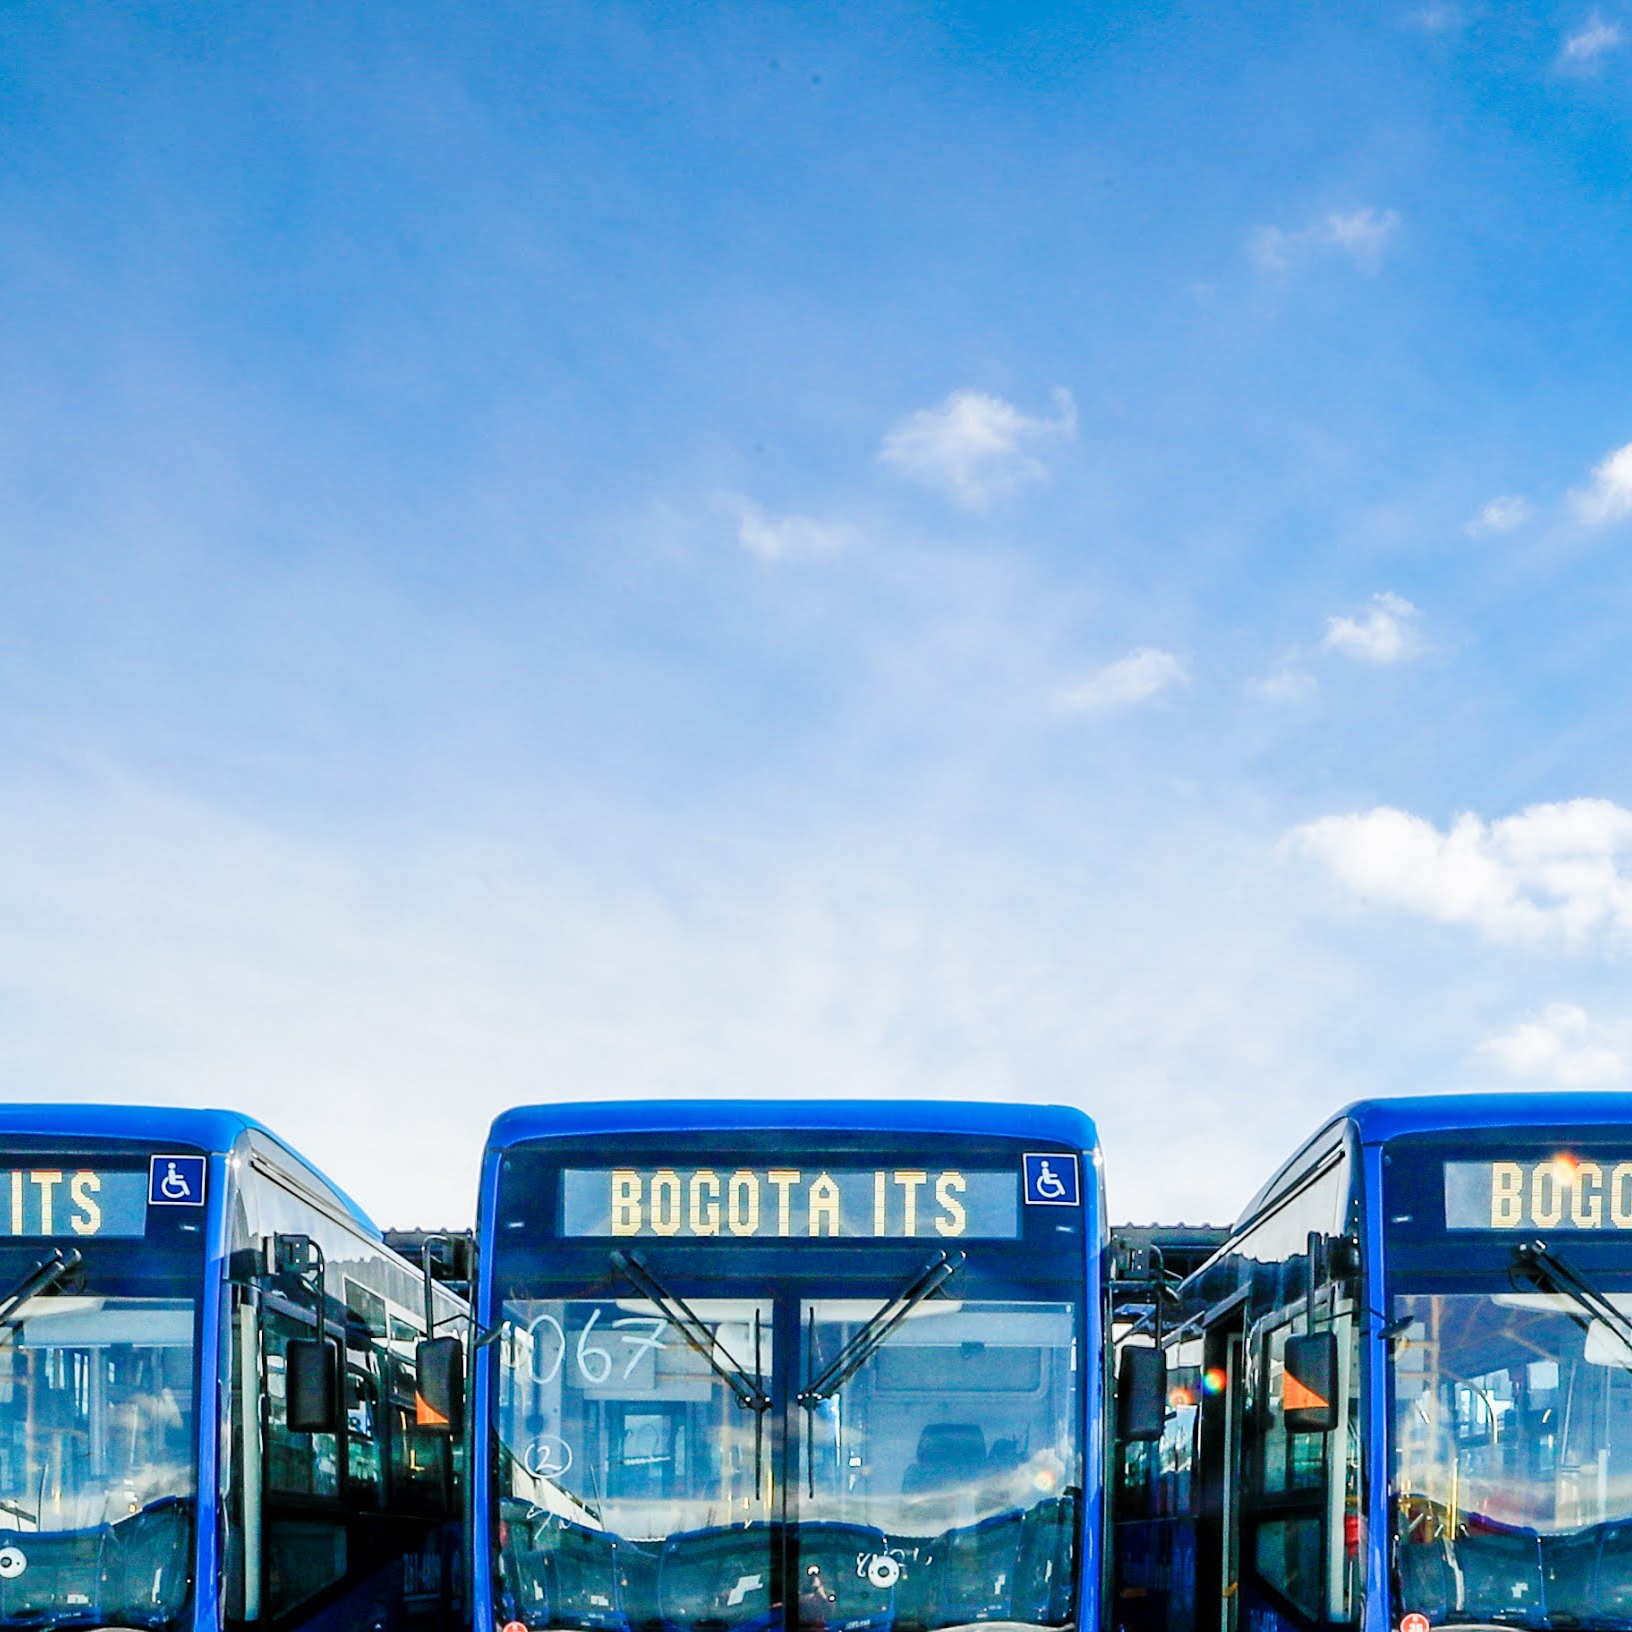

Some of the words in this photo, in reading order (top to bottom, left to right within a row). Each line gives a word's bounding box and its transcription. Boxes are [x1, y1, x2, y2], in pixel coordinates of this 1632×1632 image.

[10, 1168, 103, 1237] ITS
[610, 1167, 841, 1238] BOGOTA
[872, 1167, 968, 1238] ITS
[527, 1308, 667, 1385] 067
